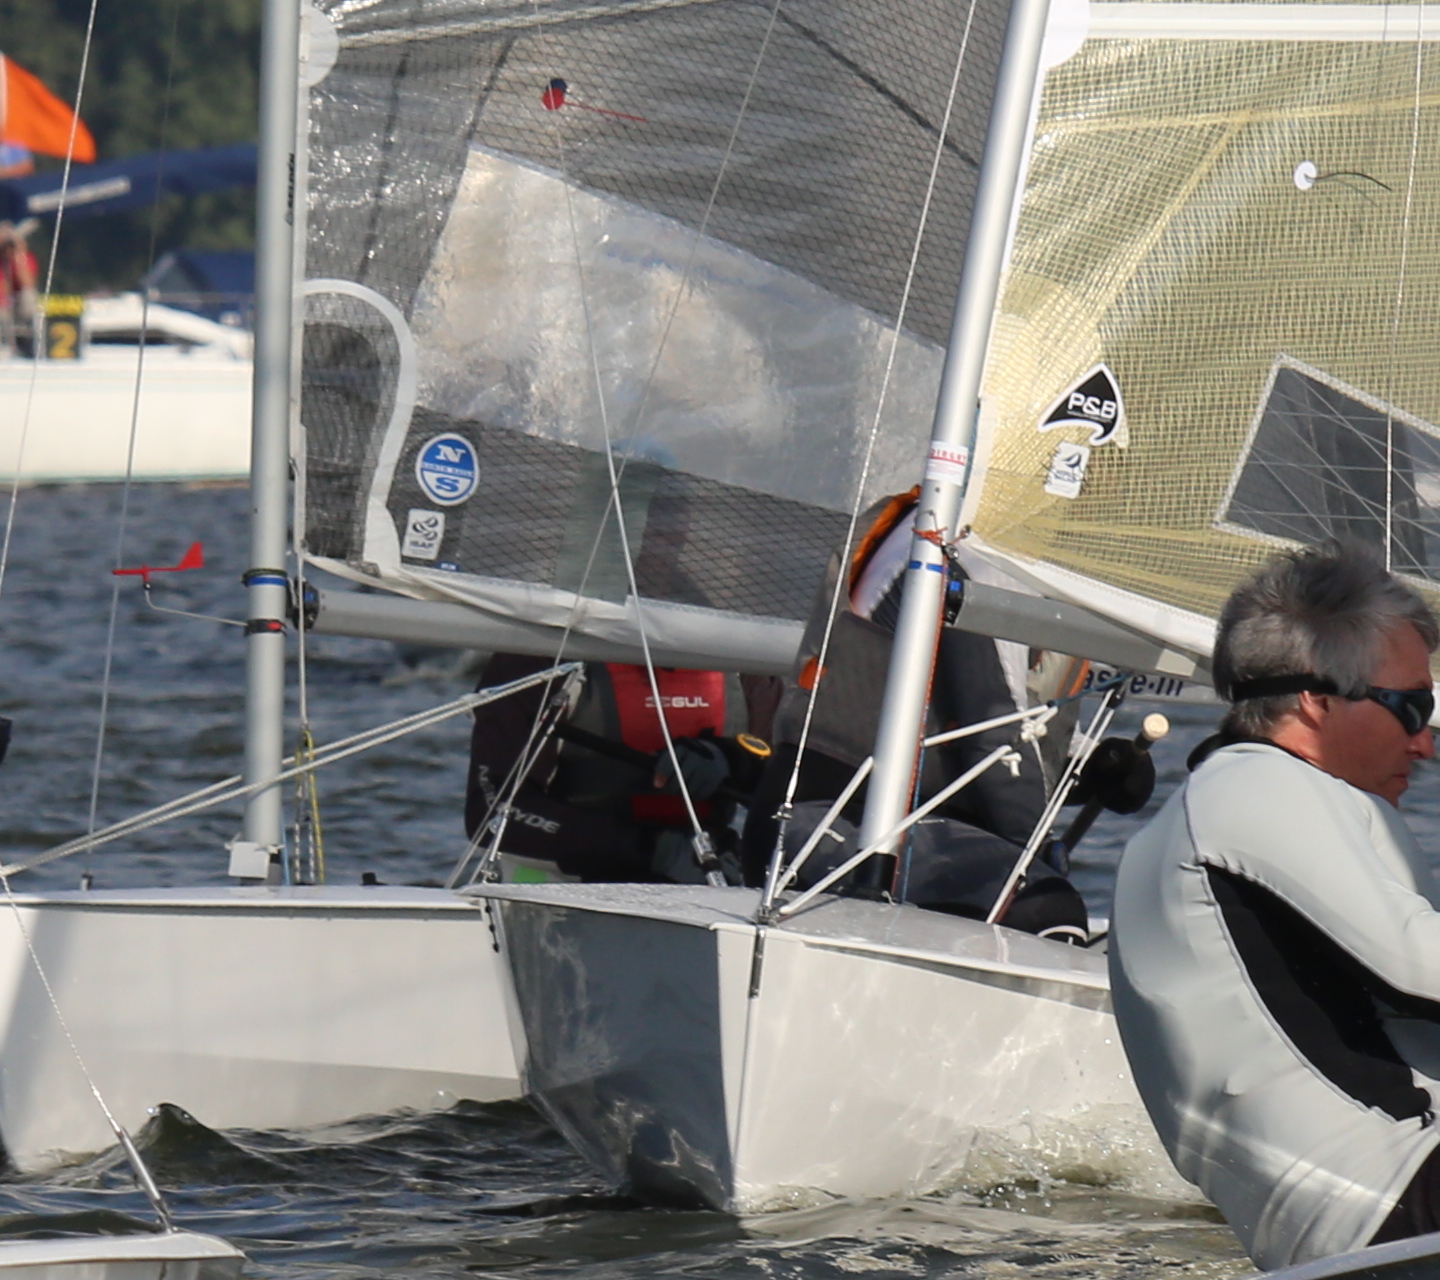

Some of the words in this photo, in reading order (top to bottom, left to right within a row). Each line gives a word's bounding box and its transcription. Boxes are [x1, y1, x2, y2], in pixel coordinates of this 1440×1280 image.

[49, 322, 78, 359] 2
[1067, 391, 1118, 420] P&B
[434, 444, 467, 464] N
[434, 476, 460, 493] S
[671, 695, 710, 708] GUL
